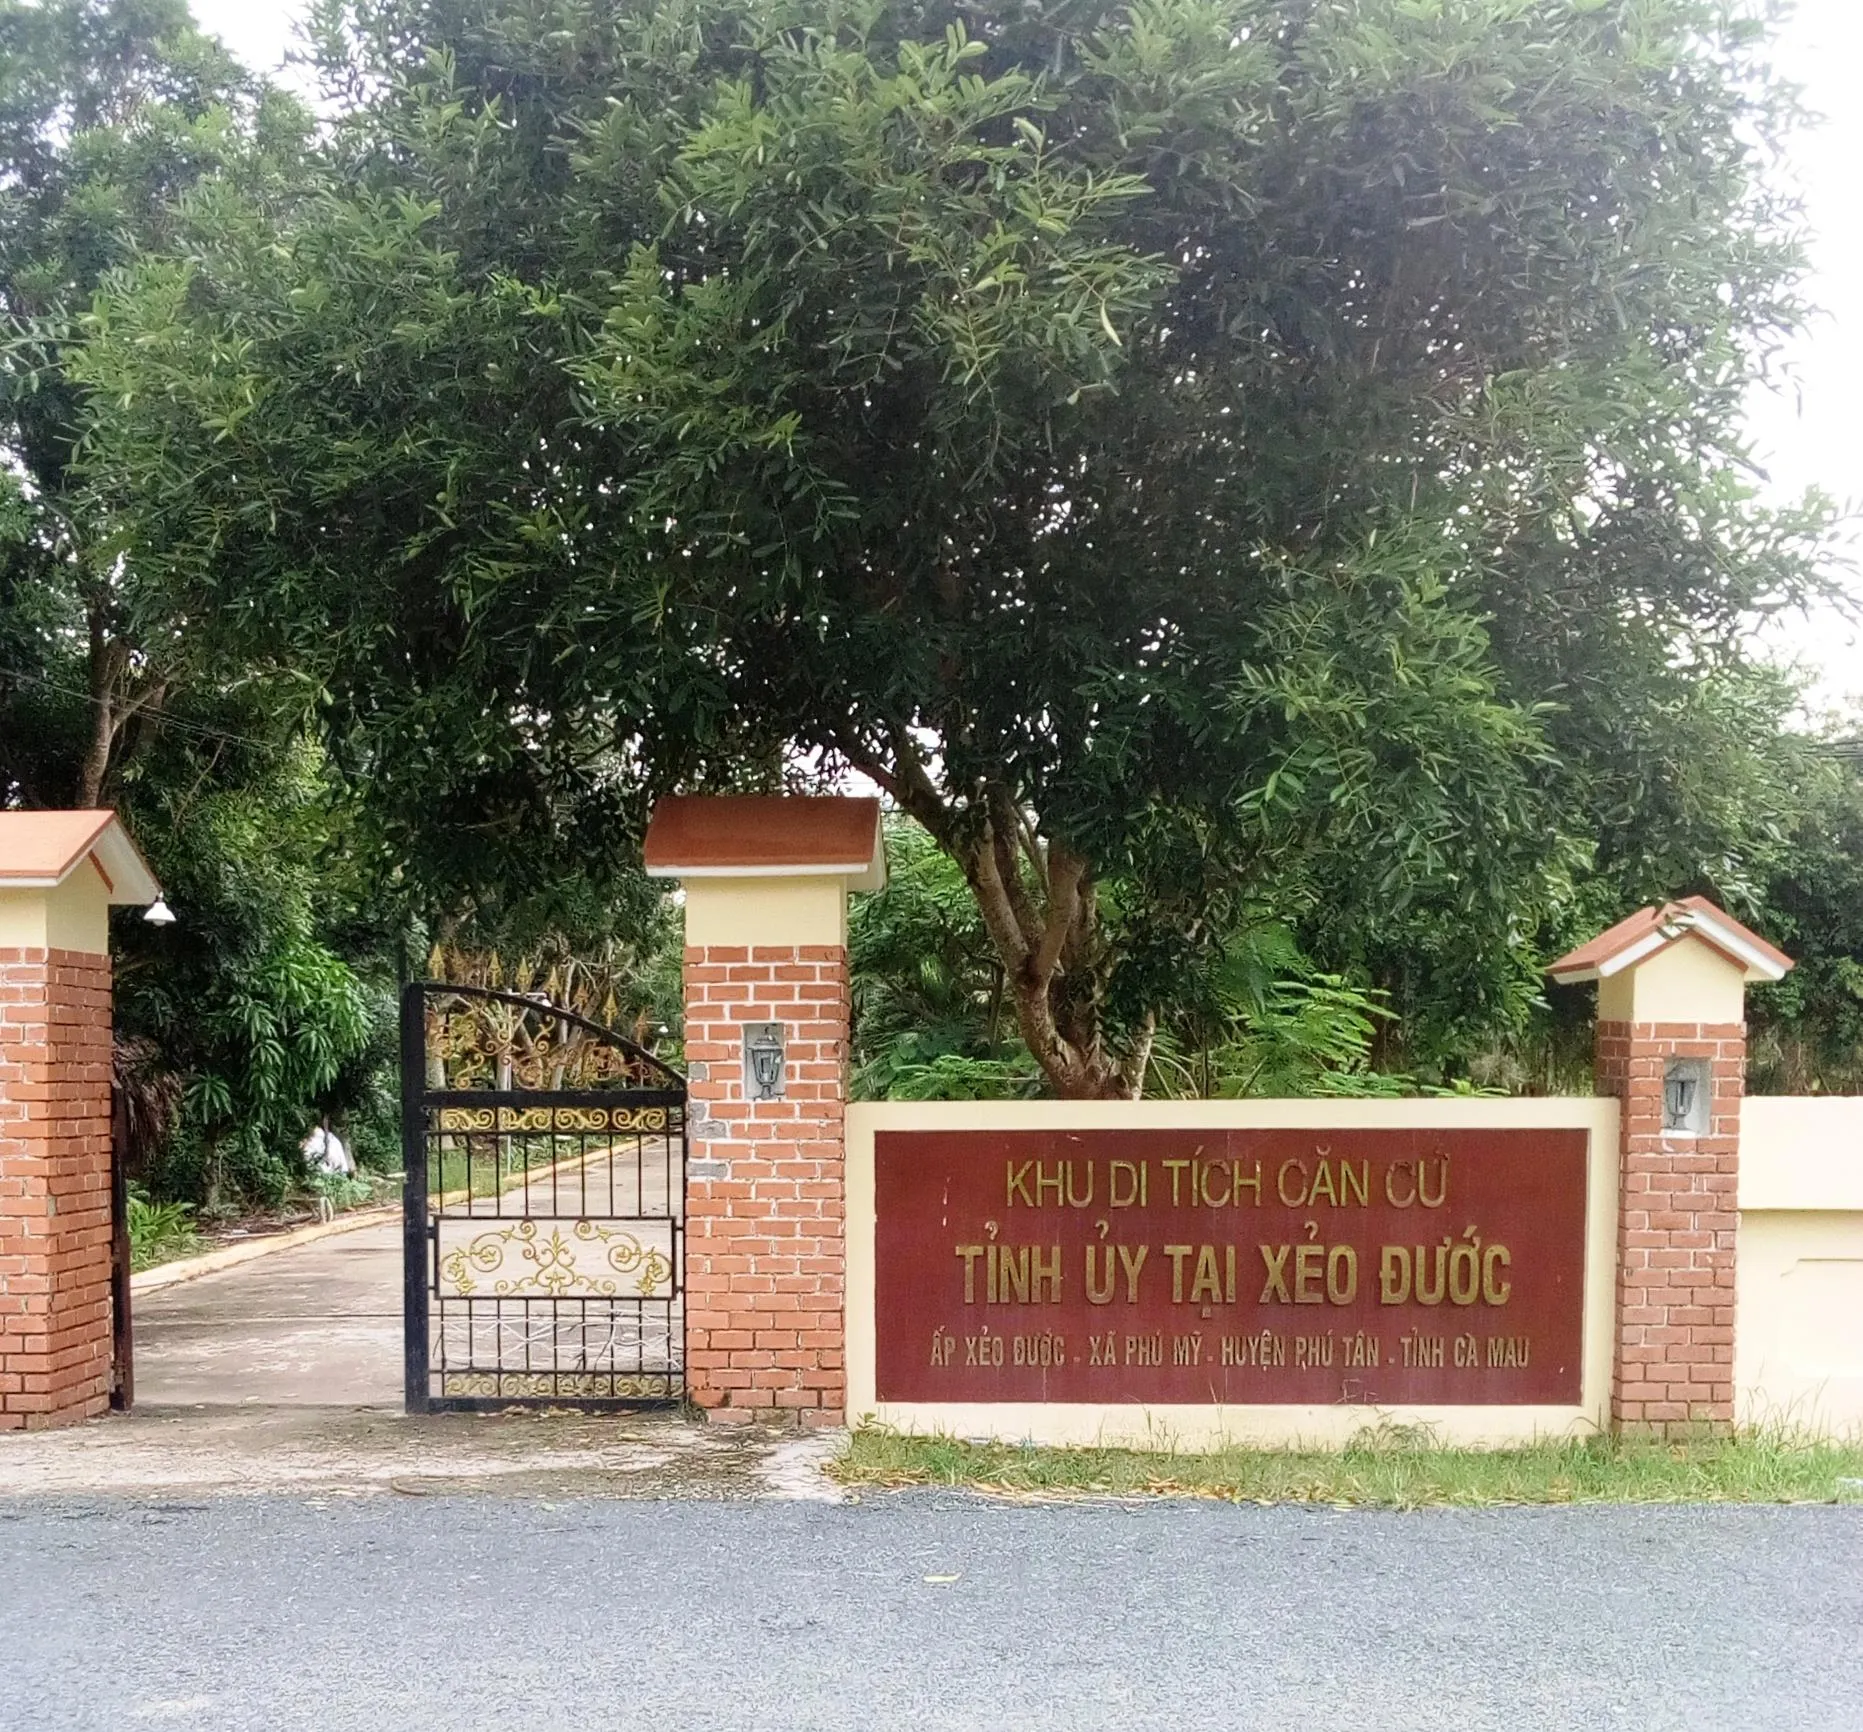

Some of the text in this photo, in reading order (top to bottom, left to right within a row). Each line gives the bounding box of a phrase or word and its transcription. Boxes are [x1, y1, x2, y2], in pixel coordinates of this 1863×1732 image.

[1007, 1160, 1093, 1208] KHU
[1110, 1160, 1147, 1208] DI
[1162, 1145, 1261, 1208] TÍCH
[1278, 1145, 1369, 1208] CĂN
[955, 1219, 1511, 1318] TỈNH ỦY TẠI XẺO ĐƯỚC
[930, 1325, 956, 1366] ẤP
[965, 1325, 1004, 1366] XẺO
[1089, 1331, 1117, 1366] XÃ
[1125, 1331, 1162, 1366] PHÚ
[1173, 1330, 1203, 1366] MỸ
[1221, 1329, 1285, 1371] HUYỆN
[1296, 1329, 1334, 1367] PHÚ
[1342, 1330, 1379, 1367] TÂN
[1400, 1326, 1445, 1367] TỈNH
[1454, 1332, 1479, 1367] CÀ
[1487, 1337, 1529, 1367] MAU
